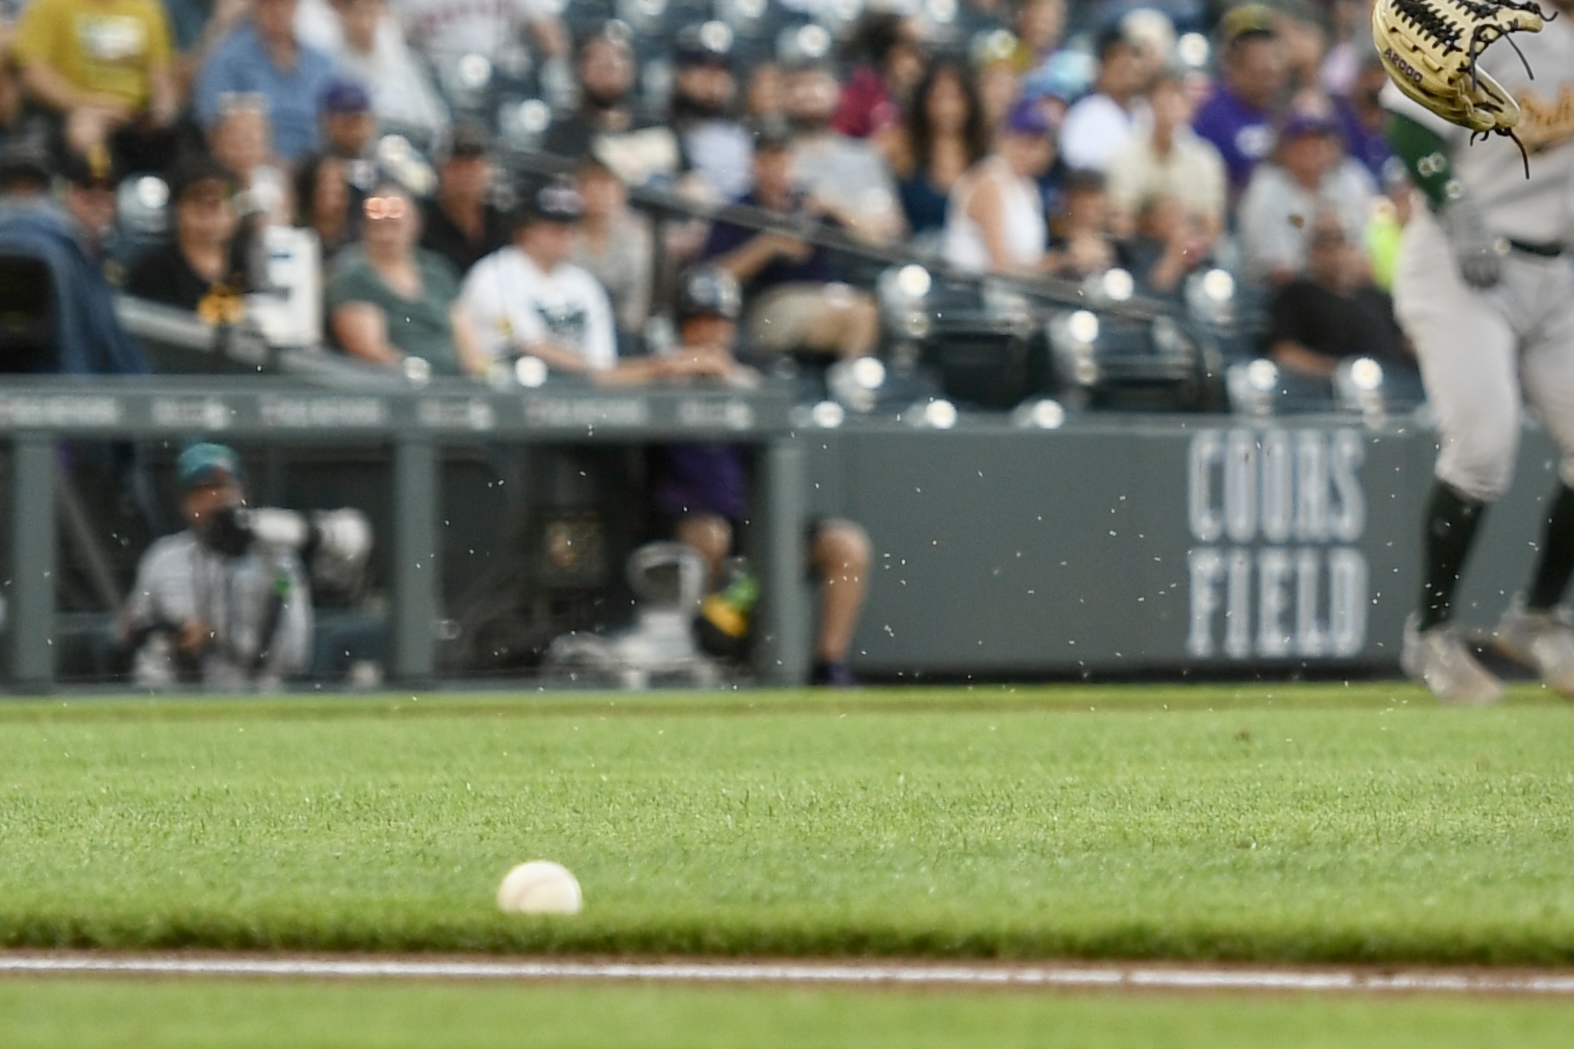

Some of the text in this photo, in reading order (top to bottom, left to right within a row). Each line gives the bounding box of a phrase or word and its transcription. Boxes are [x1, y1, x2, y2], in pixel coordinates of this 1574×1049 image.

[1384, 46, 1424, 84] A2000
[1188, 426, 1367, 543] COORS
[1187, 548, 1369, 658] FIELD
